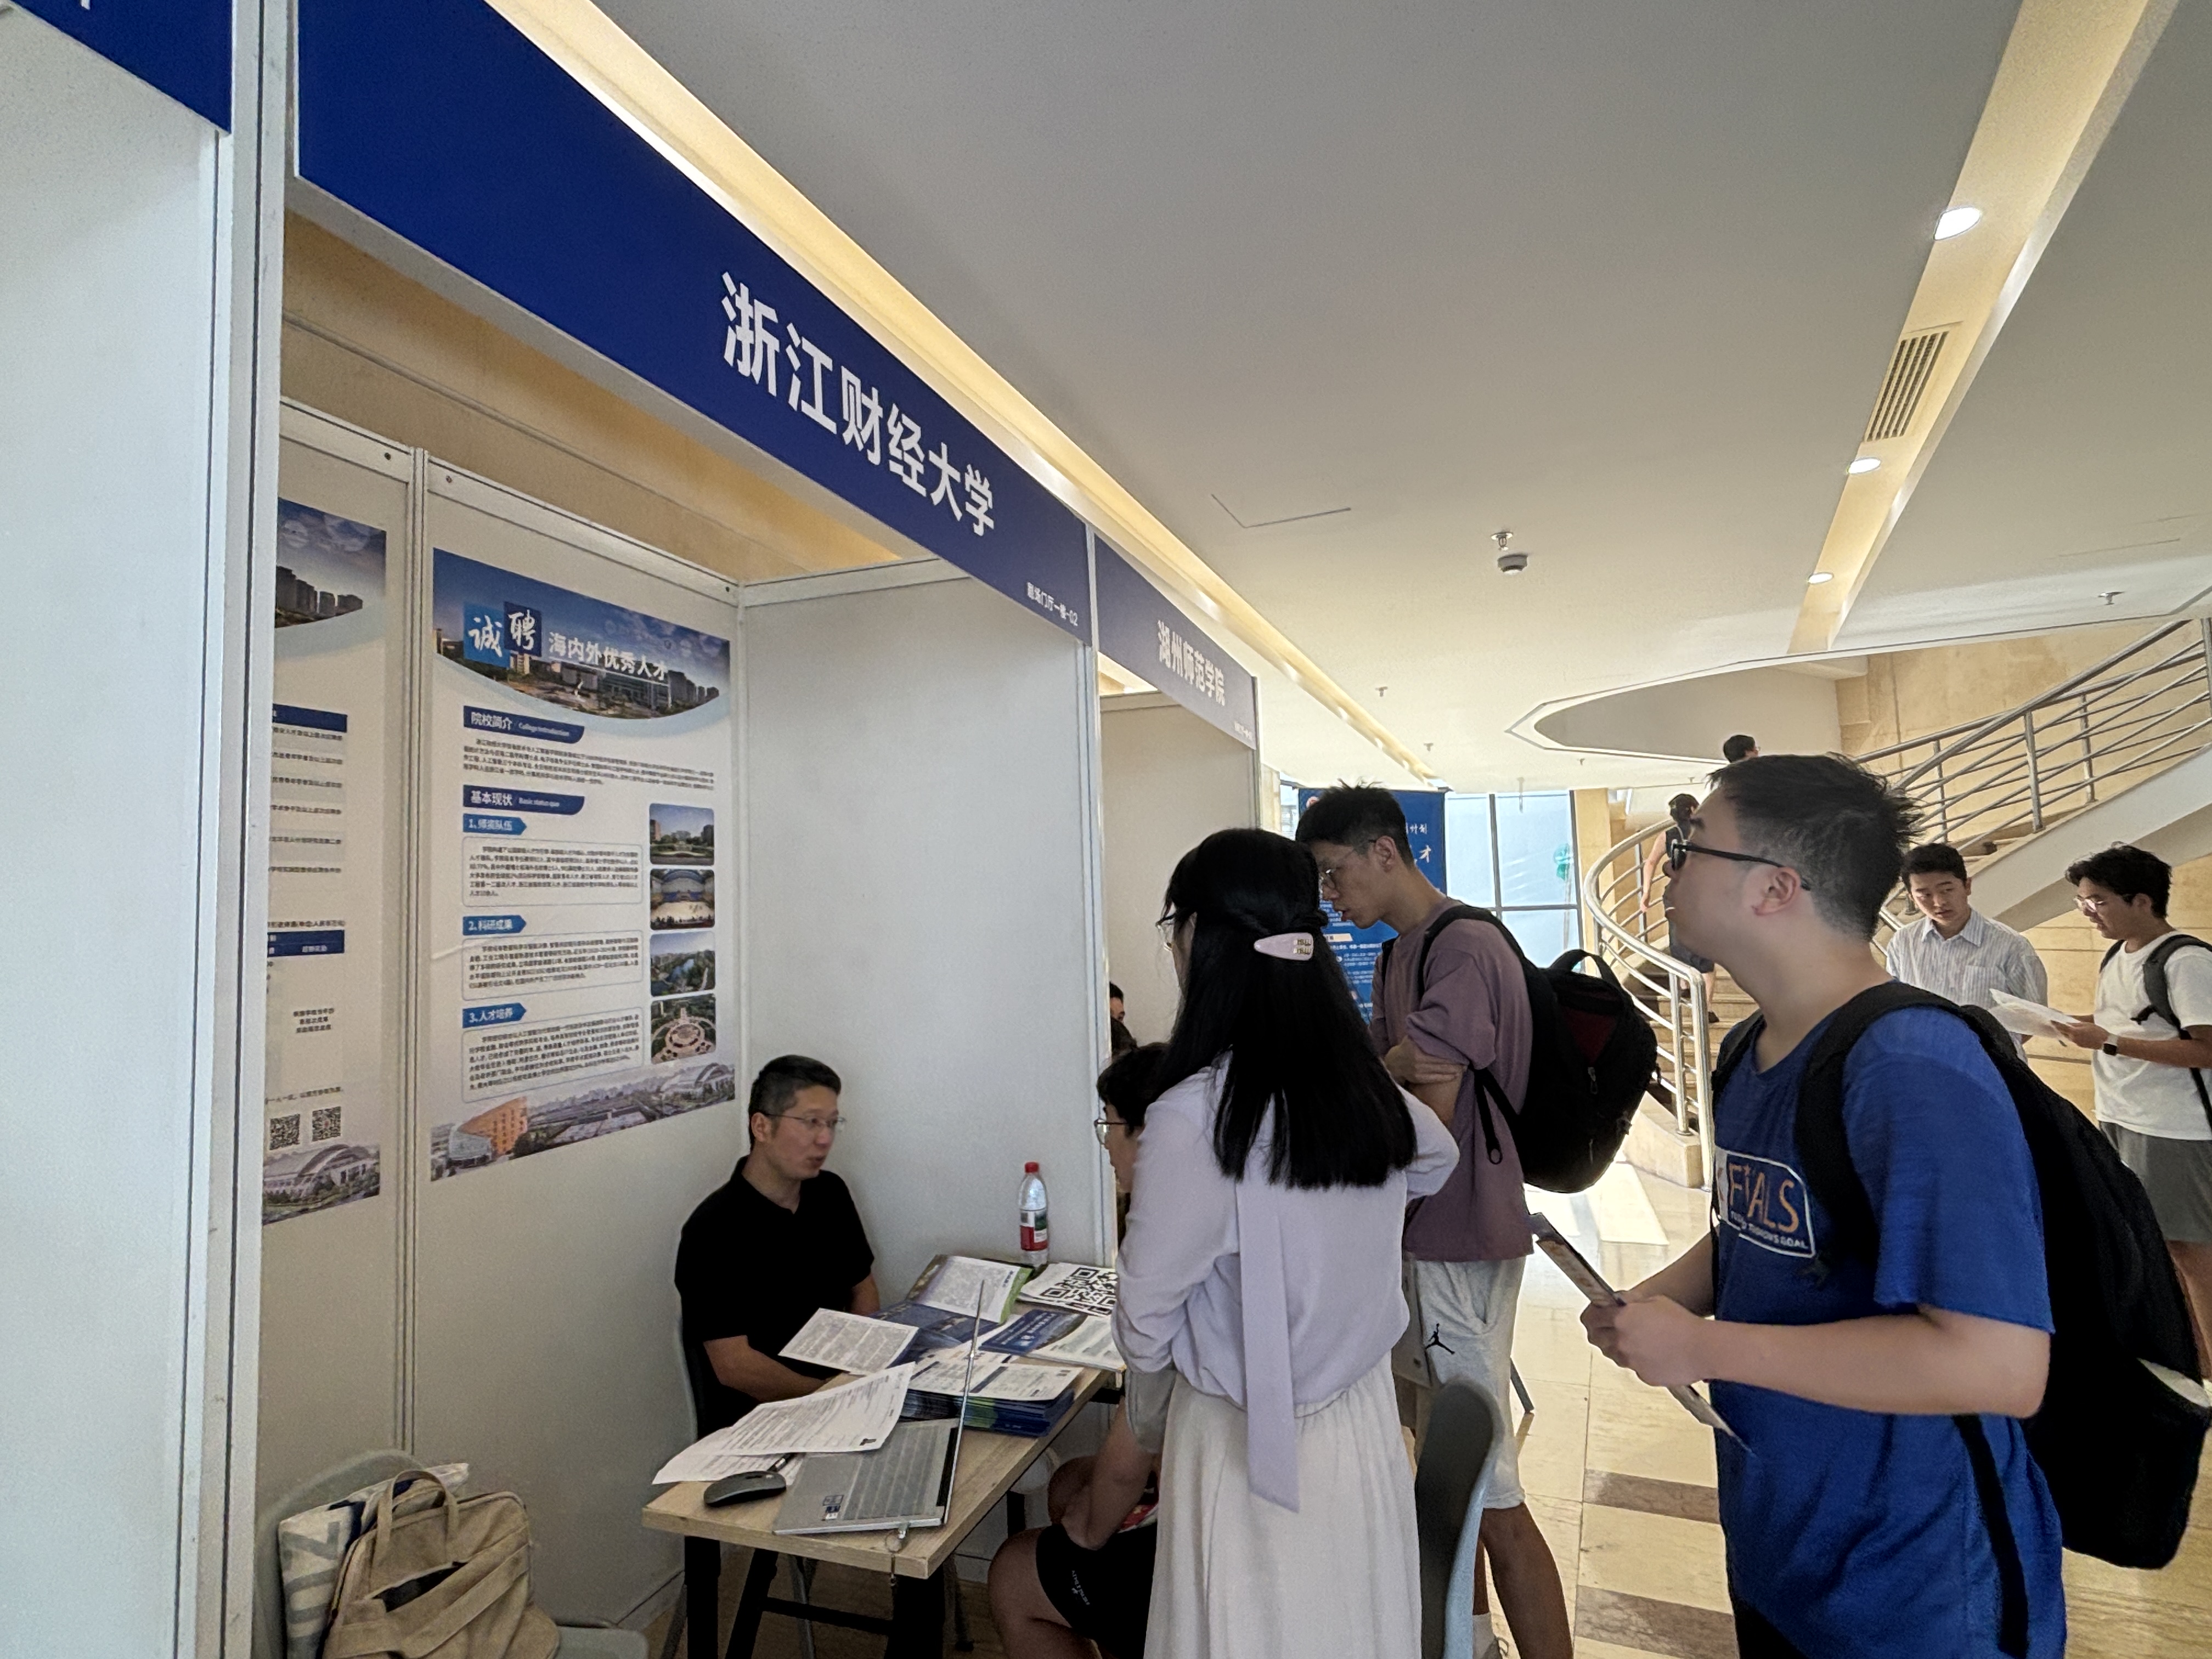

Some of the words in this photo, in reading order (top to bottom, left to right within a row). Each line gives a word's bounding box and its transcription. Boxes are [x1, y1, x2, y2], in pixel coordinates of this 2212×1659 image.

[722, 271, 995, 537] 浙江财经大学
[549, 631, 669, 681] 海内外优秀人才
[1158, 620, 1226, 707] 湖州师范学院
[470, 712, 512, 731] 院校简介
[471, 790, 513, 806] 基本现状
[1406, 822, 1427, 834] 计划
